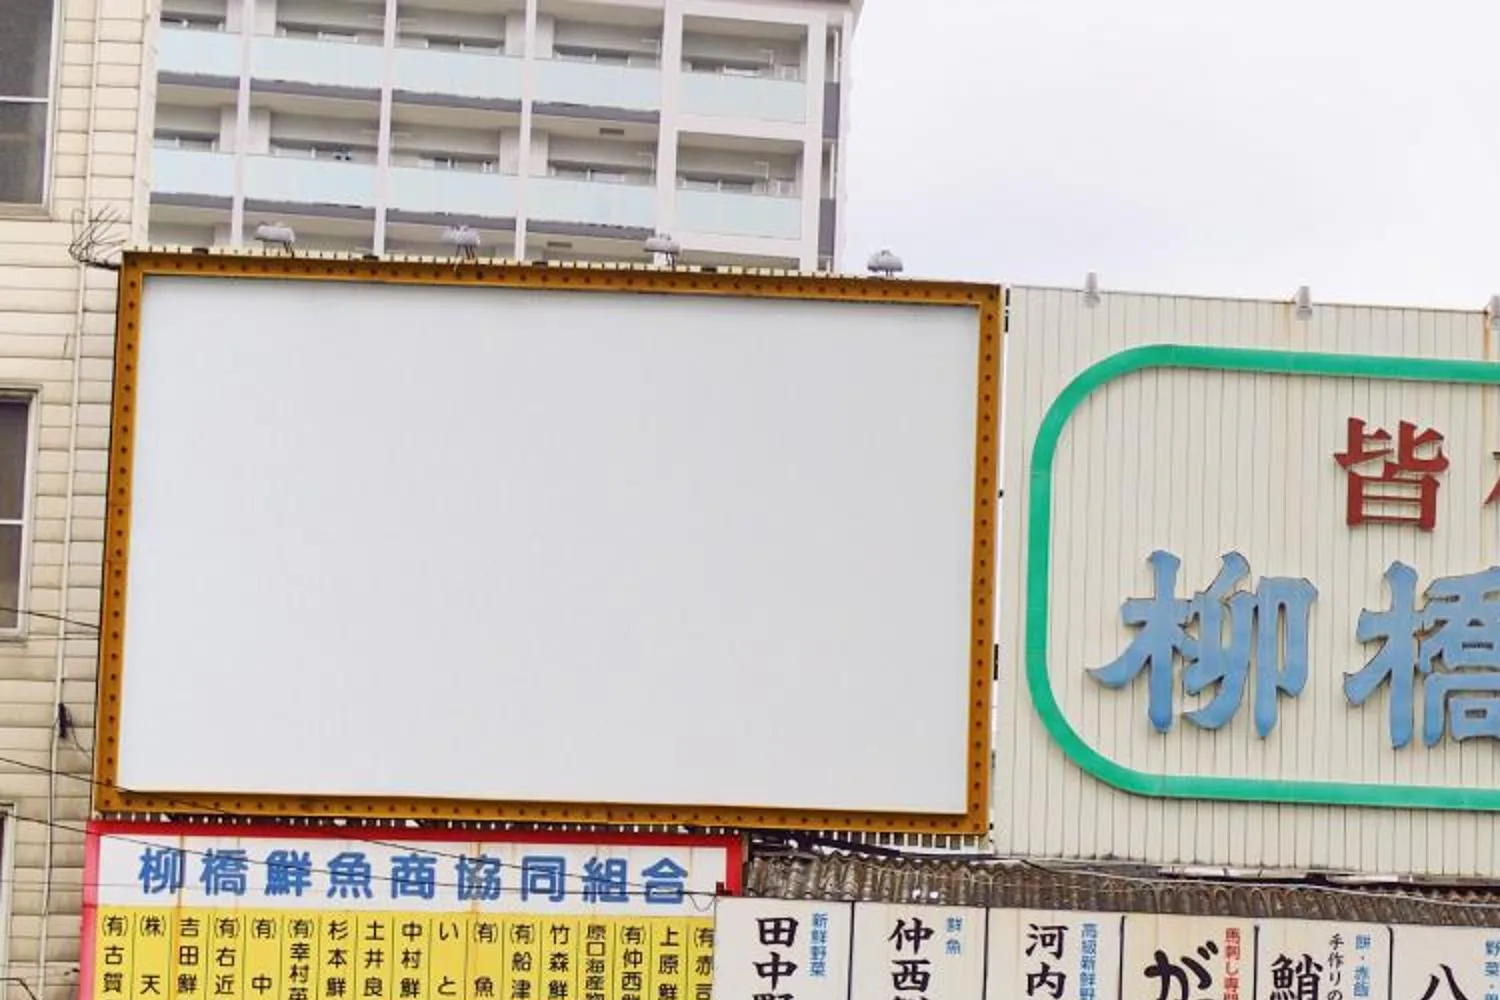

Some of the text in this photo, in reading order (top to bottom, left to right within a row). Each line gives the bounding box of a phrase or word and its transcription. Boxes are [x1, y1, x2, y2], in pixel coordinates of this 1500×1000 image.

[139, 847, 688, 904] 柳橋鮮魚商協同組合
[945, 917, 963, 956] 鮮魚
